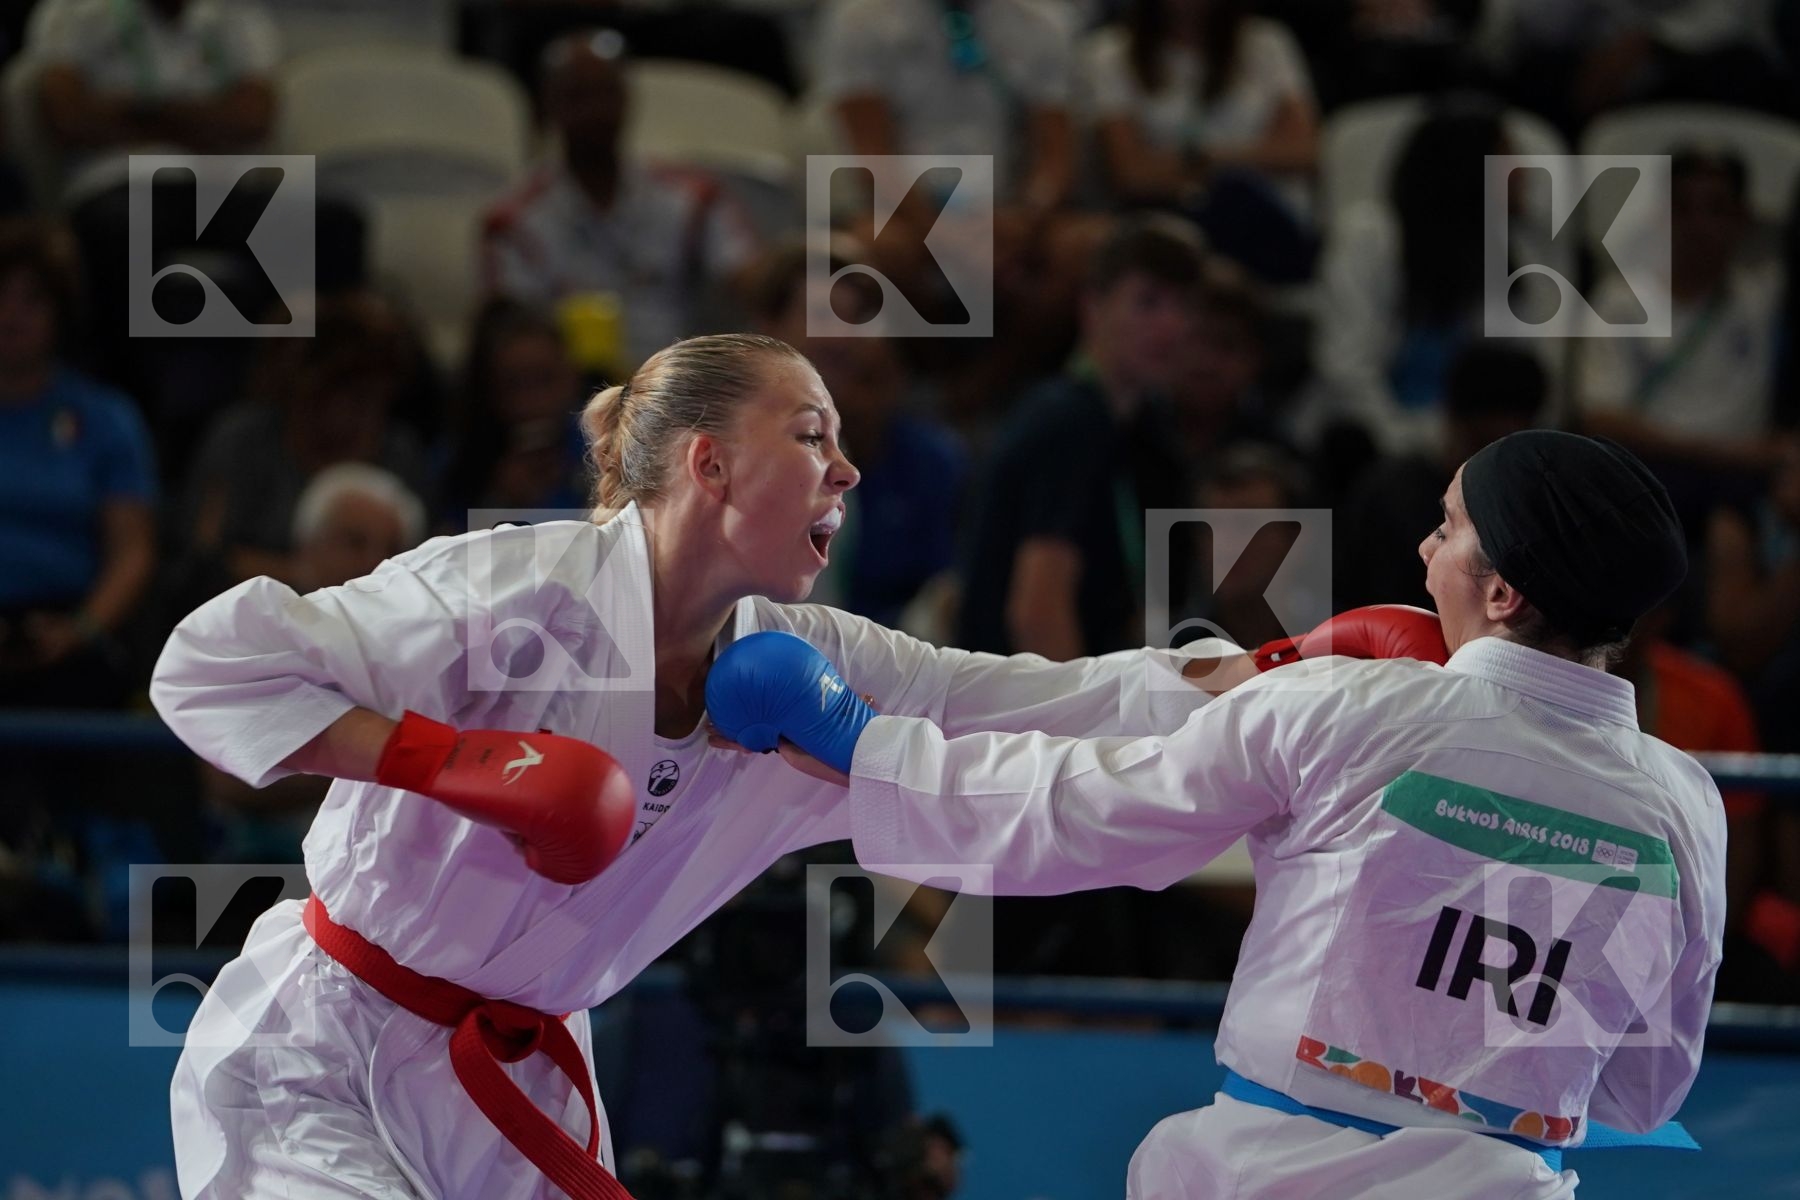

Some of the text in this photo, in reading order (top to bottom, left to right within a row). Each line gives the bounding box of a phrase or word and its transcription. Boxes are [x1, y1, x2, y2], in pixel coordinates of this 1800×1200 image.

[1435, 799, 1590, 856] BUENOS AIRES 2018
[1416, 905, 1572, 1026] IRI
